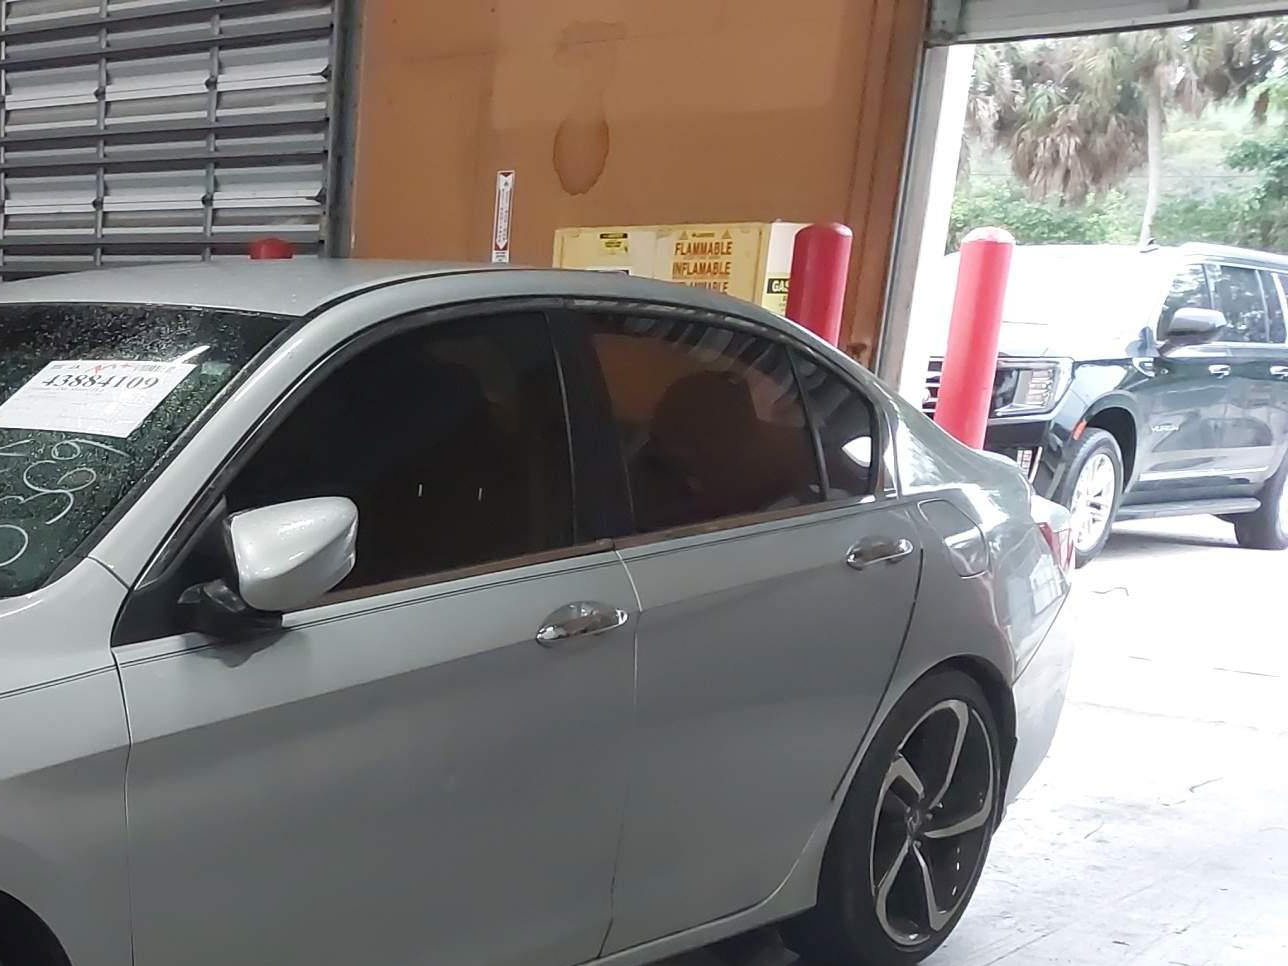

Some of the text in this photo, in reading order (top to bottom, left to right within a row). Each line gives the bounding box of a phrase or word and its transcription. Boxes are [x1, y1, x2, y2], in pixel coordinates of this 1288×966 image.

[674, 240, 733, 256] FLAMMABLE
[672, 261, 732, 276] INFLAMABLE
[41, 374, 160, 390] 43884109
